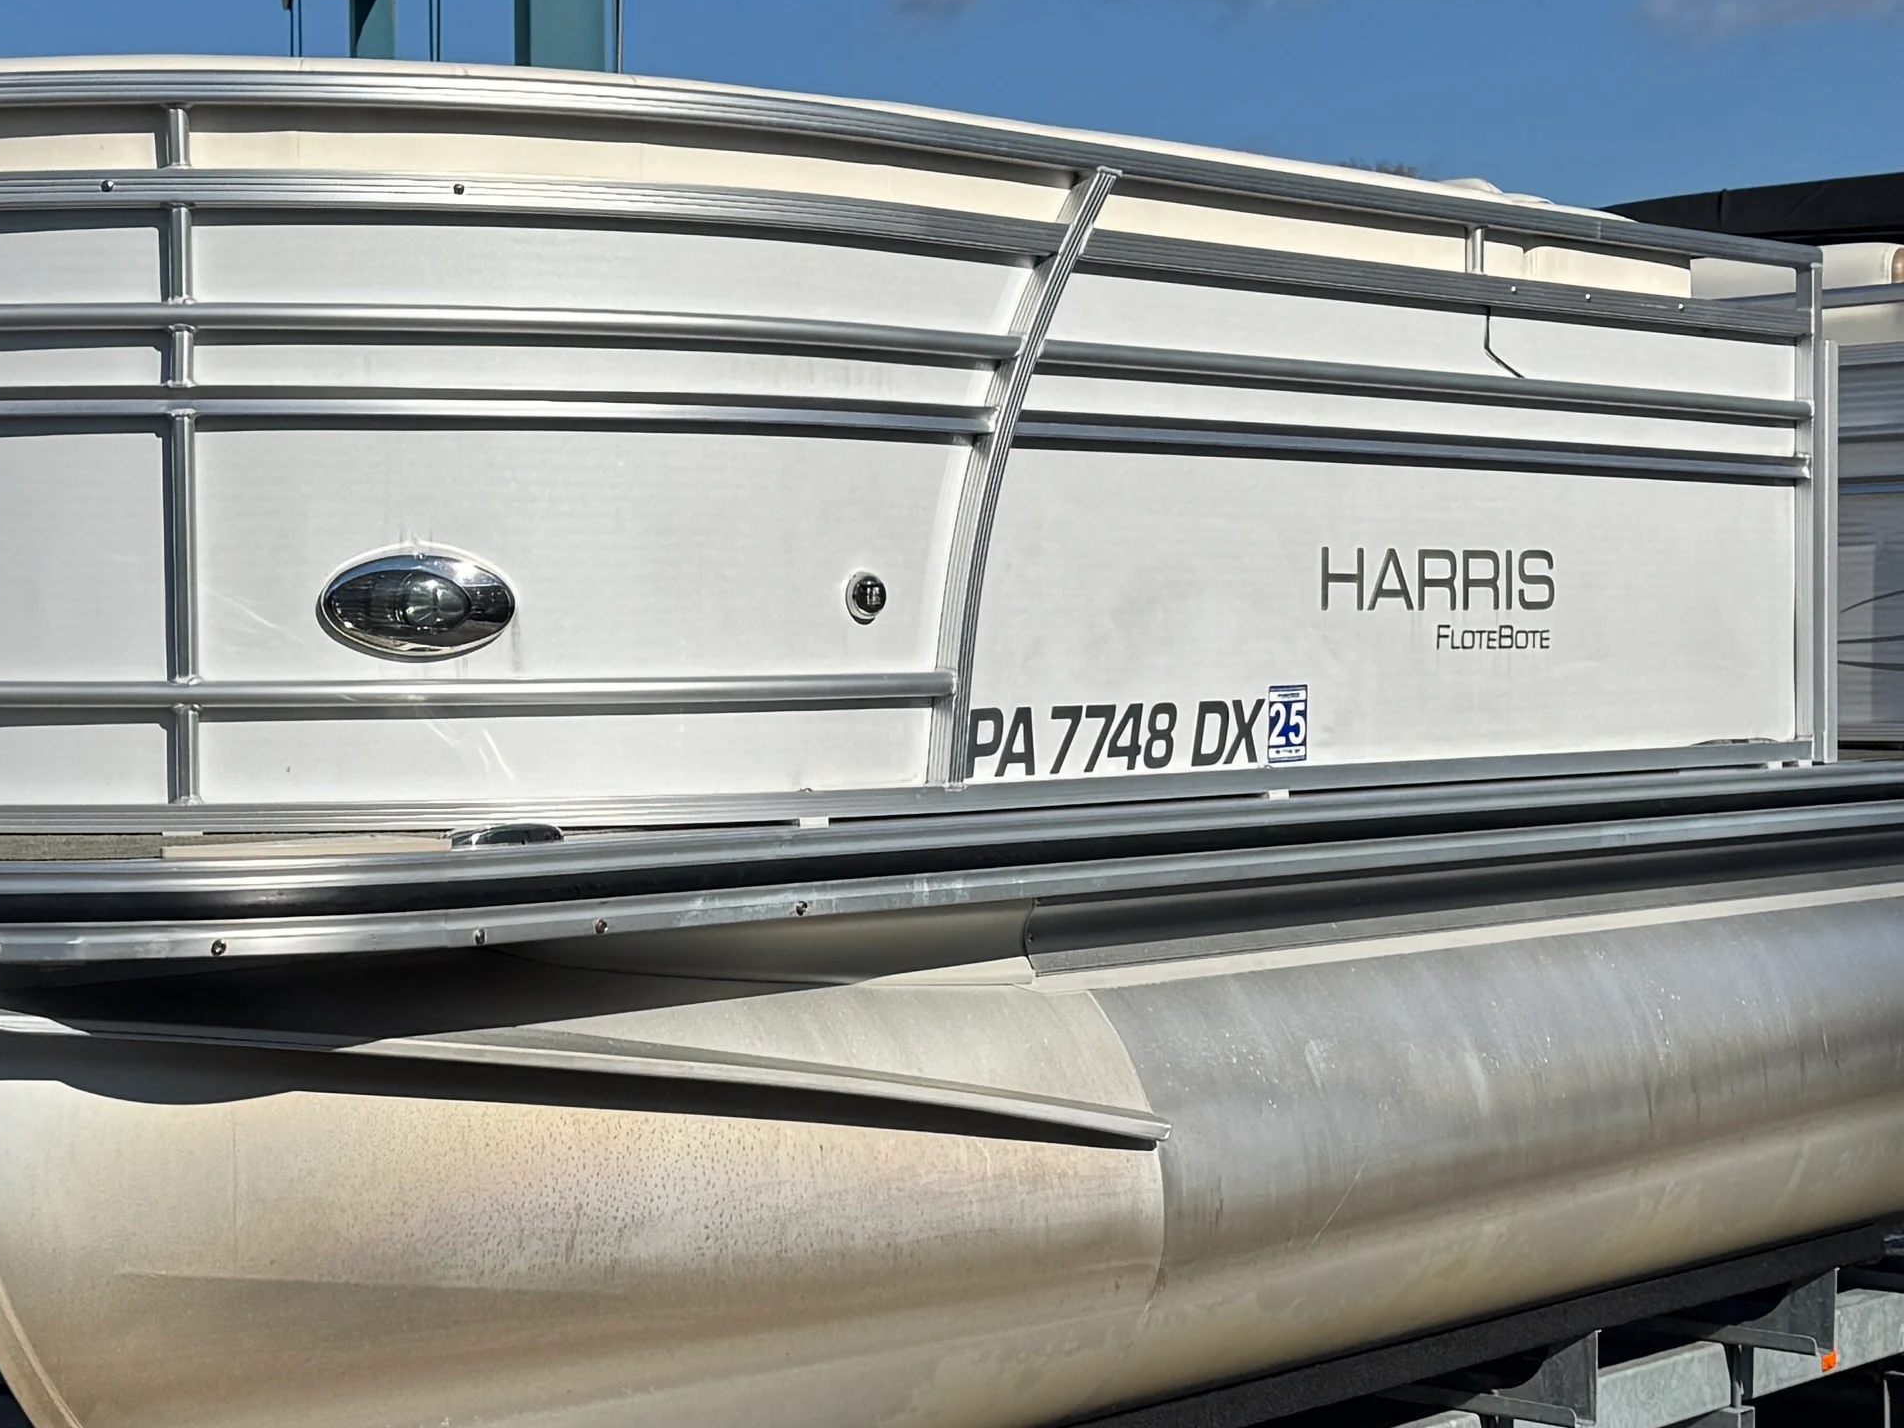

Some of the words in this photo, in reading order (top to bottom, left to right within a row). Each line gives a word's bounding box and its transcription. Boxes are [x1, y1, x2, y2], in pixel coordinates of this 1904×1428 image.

[1321, 546, 1555, 611] HARRIS
[964, 706, 1036, 779] PA
[1049, 702, 1178, 775] 7748
[1191, 698, 1266, 767] DX
[1268, 702, 1306, 746] 25
